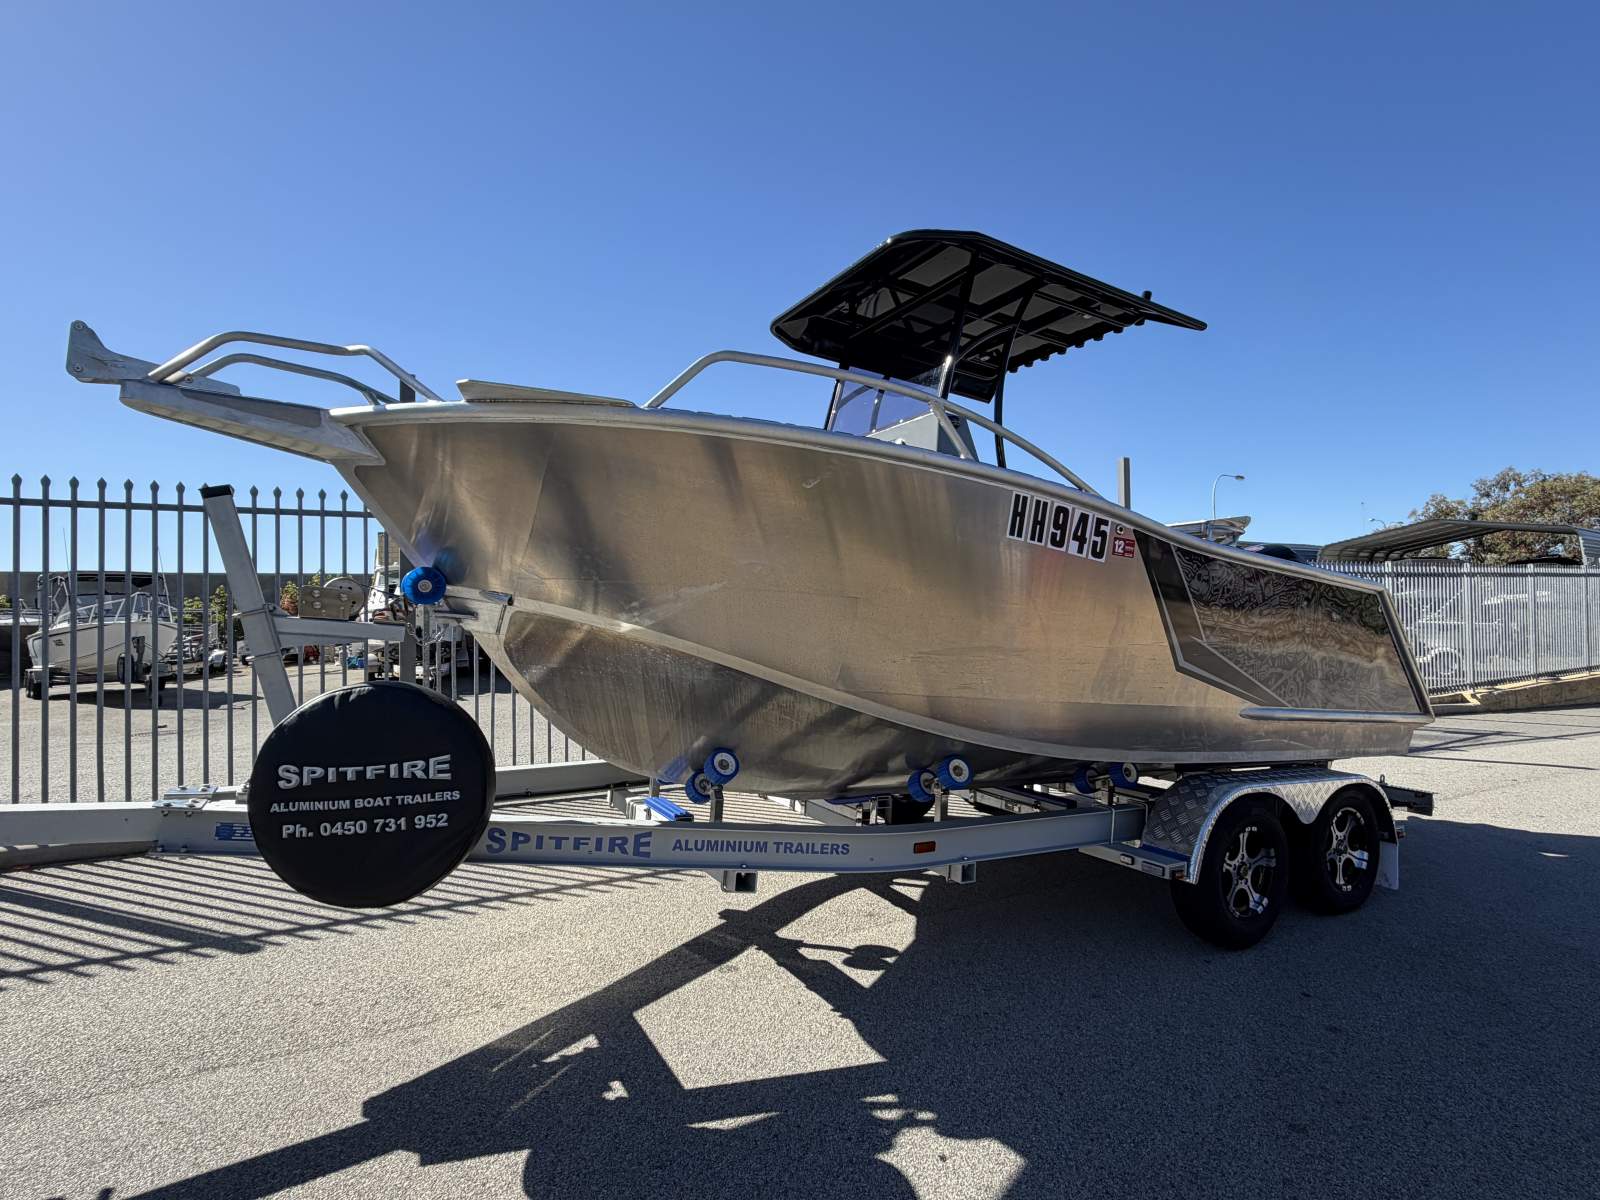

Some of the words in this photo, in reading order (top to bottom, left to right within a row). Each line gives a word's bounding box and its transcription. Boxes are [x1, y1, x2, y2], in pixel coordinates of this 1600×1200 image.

[1008, 493, 1110, 560] HH945
[1114, 540, 1125, 553] 12
[277, 754, 452, 789] SPITFIRE
[270, 800, 350, 813] ALUMINIUM
[354, 797, 392, 808] BOAT
[396, 790, 461, 805] TRAILERS
[282, 824, 314, 838] Ph.
[320, 820, 368, 837] 0450
[373, 817, 407, 833] 731
[414, 813, 449, 829] 952
[486, 827, 652, 858] SPITFIRE
[672, 839, 768, 853] ALUMINIUM
[773, 842, 851, 855] TRAILERS
